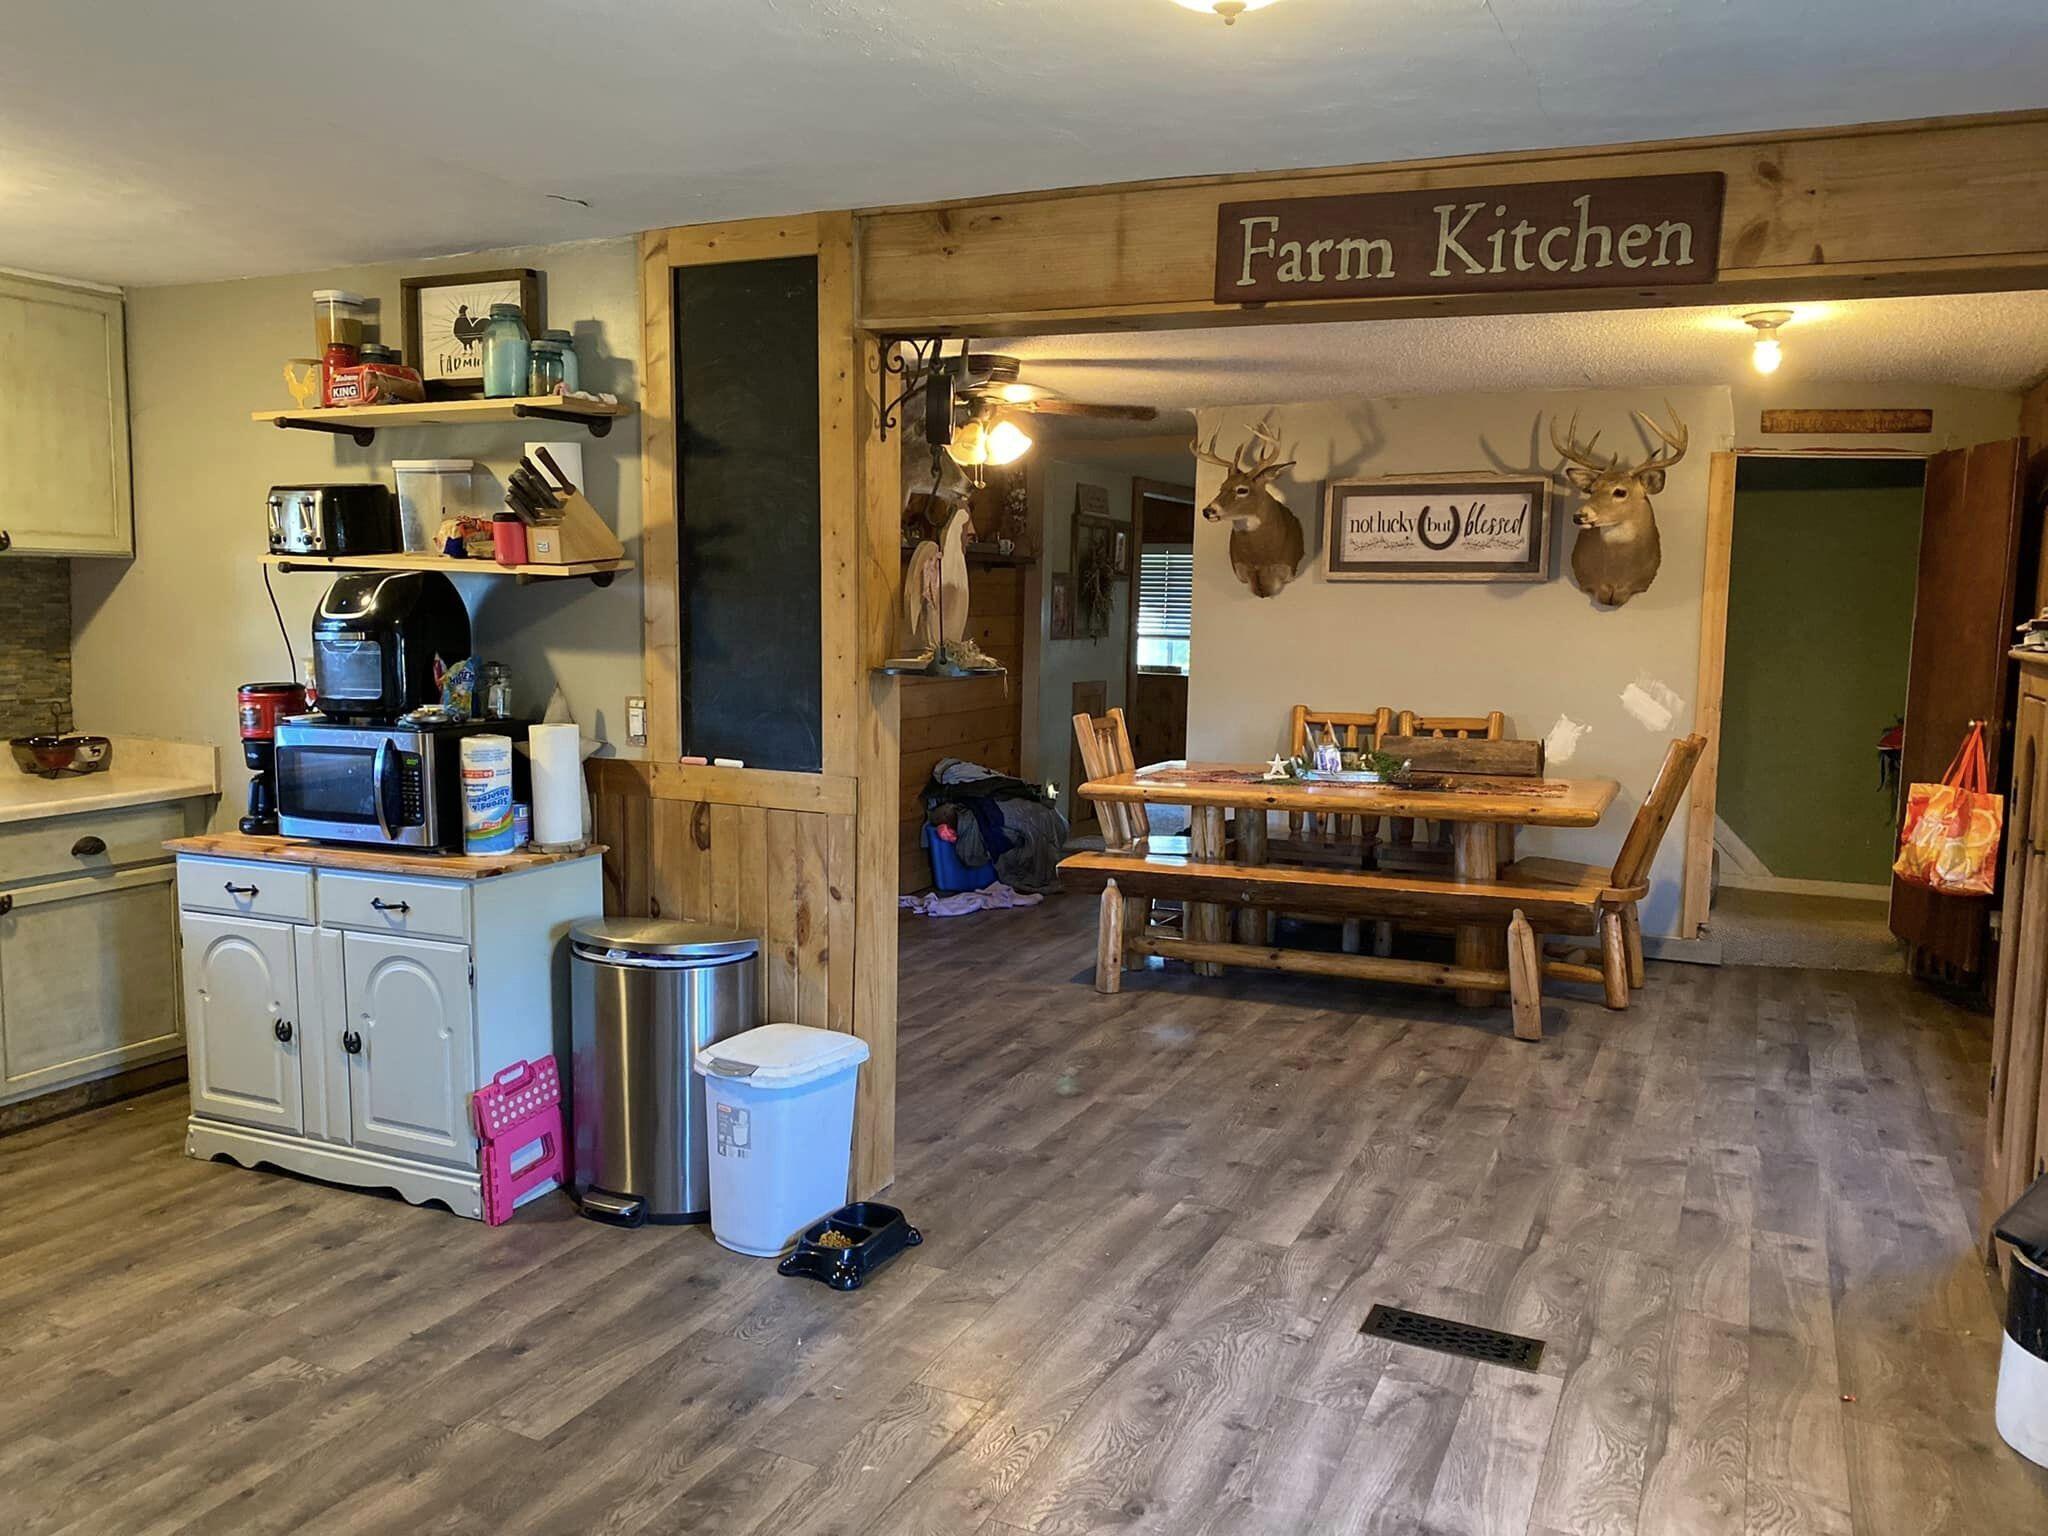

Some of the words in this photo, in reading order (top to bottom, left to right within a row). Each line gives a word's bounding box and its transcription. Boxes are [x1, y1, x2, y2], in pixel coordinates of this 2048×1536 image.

[1236, 215, 1396, 287] Farm
[1429, 193, 1695, 278] Kitchen
[333, 386, 357, 398] KING
[1350, 517, 1374, 534] not
[1377, 510, 1418, 540] lucky
[1427, 517, 1452, 532] but
[1463, 501, 1528, 538] blessed
